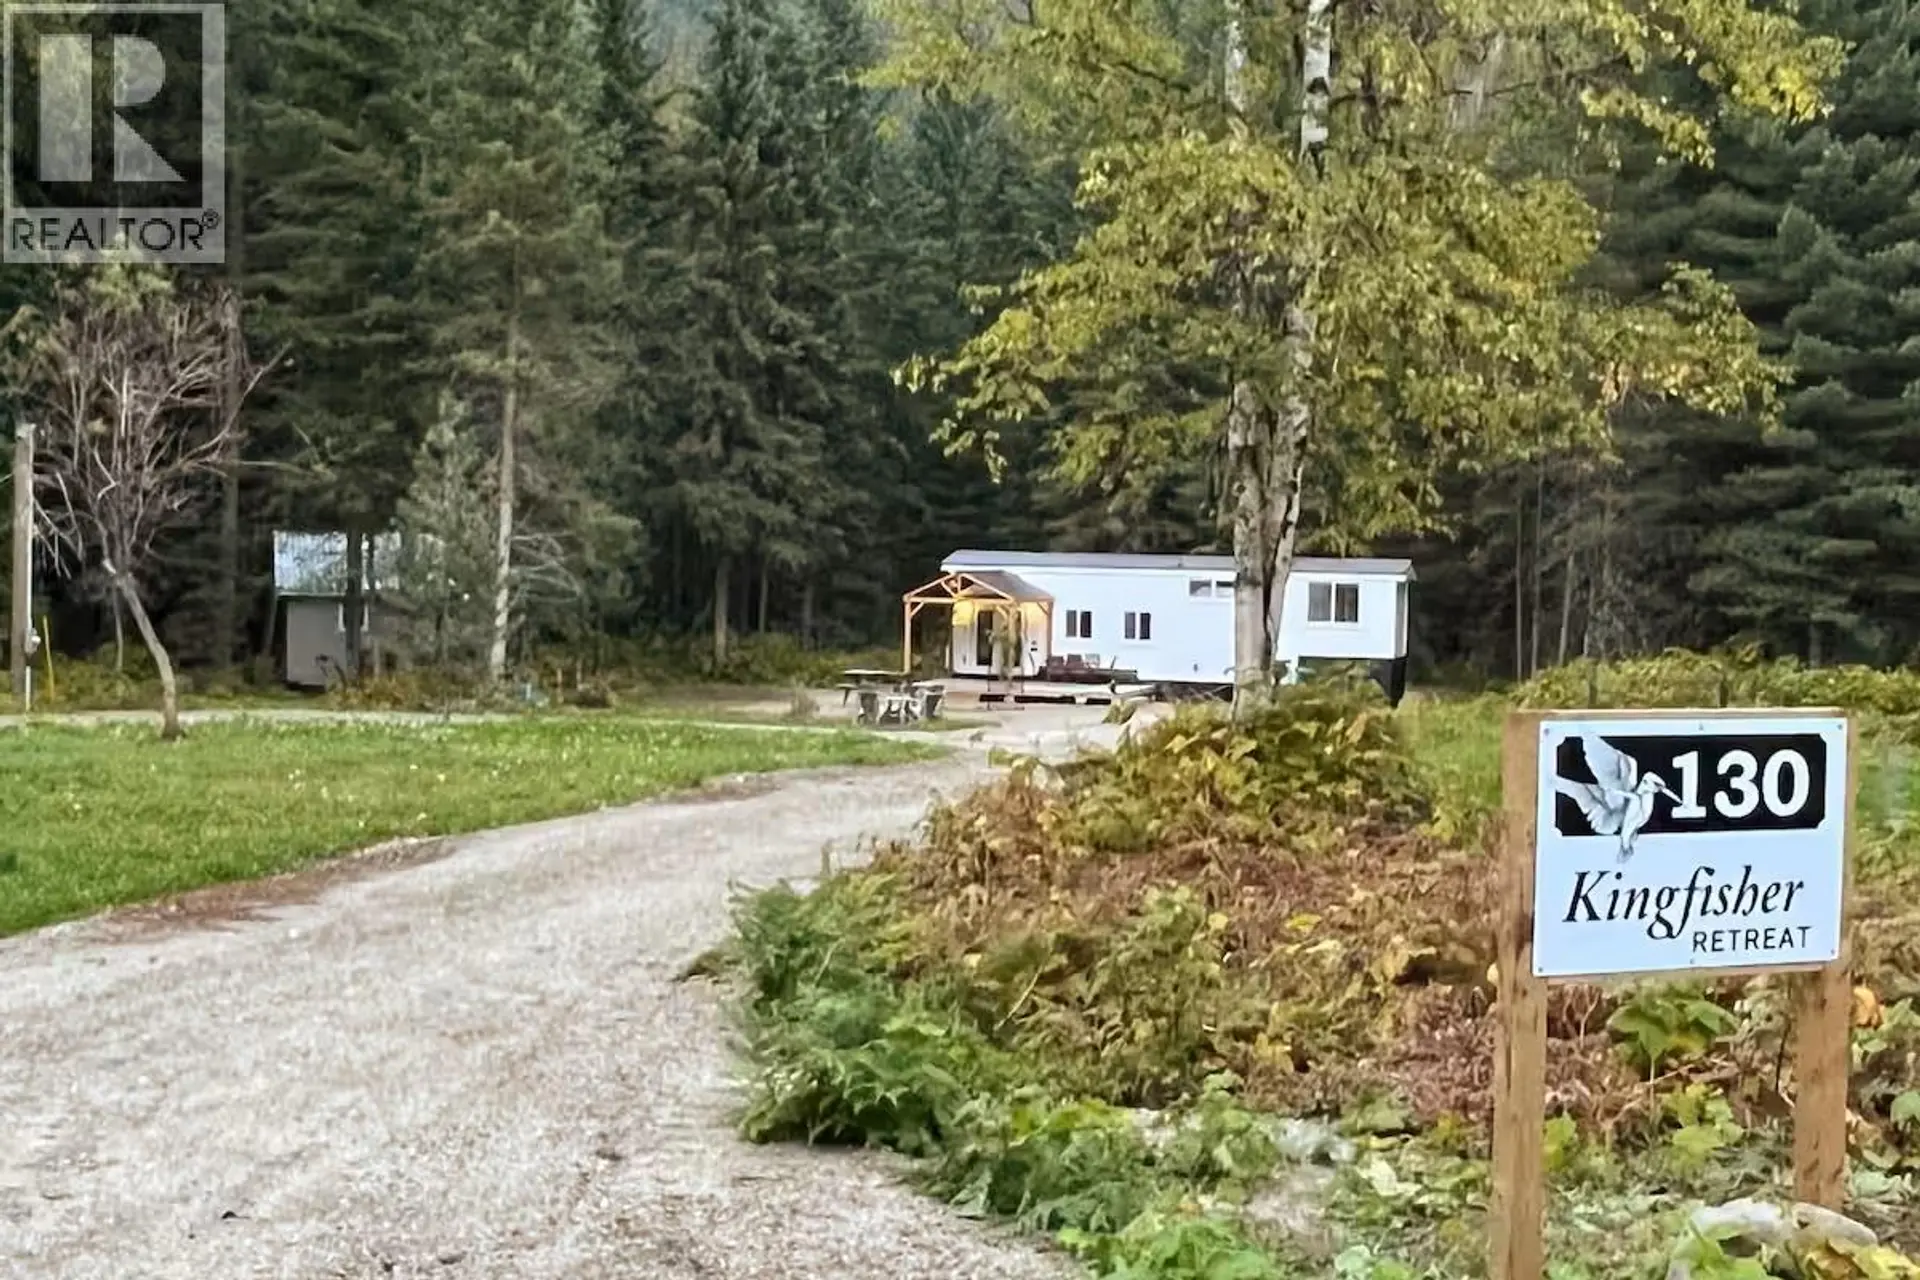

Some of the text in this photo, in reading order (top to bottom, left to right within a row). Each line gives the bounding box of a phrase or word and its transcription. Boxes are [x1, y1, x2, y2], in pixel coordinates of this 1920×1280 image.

[1671, 748, 1810, 819] 130
[1562, 864, 1804, 940] Kingfisher
[1692, 926, 1811, 952] RETREAT
